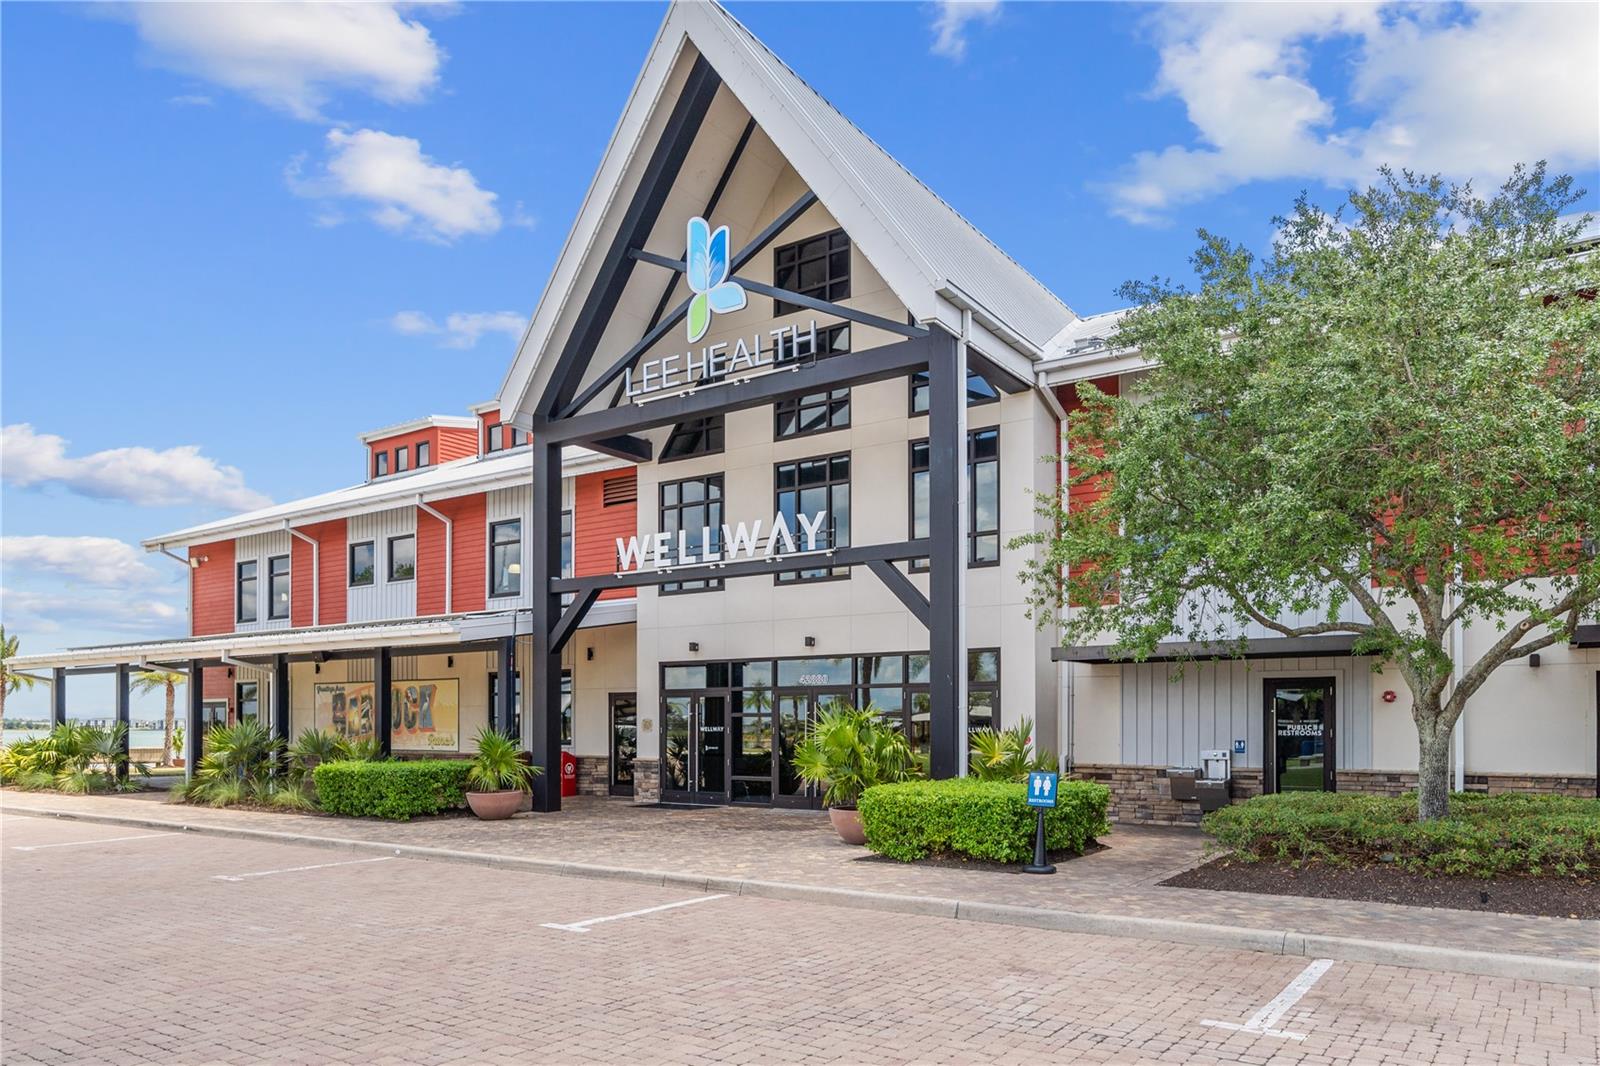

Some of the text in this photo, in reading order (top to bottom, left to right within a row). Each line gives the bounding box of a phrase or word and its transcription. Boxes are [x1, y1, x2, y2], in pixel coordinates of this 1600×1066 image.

[625, 320, 817, 397] LEE HEALTH
[615, 510, 827, 571] WELLWAY
